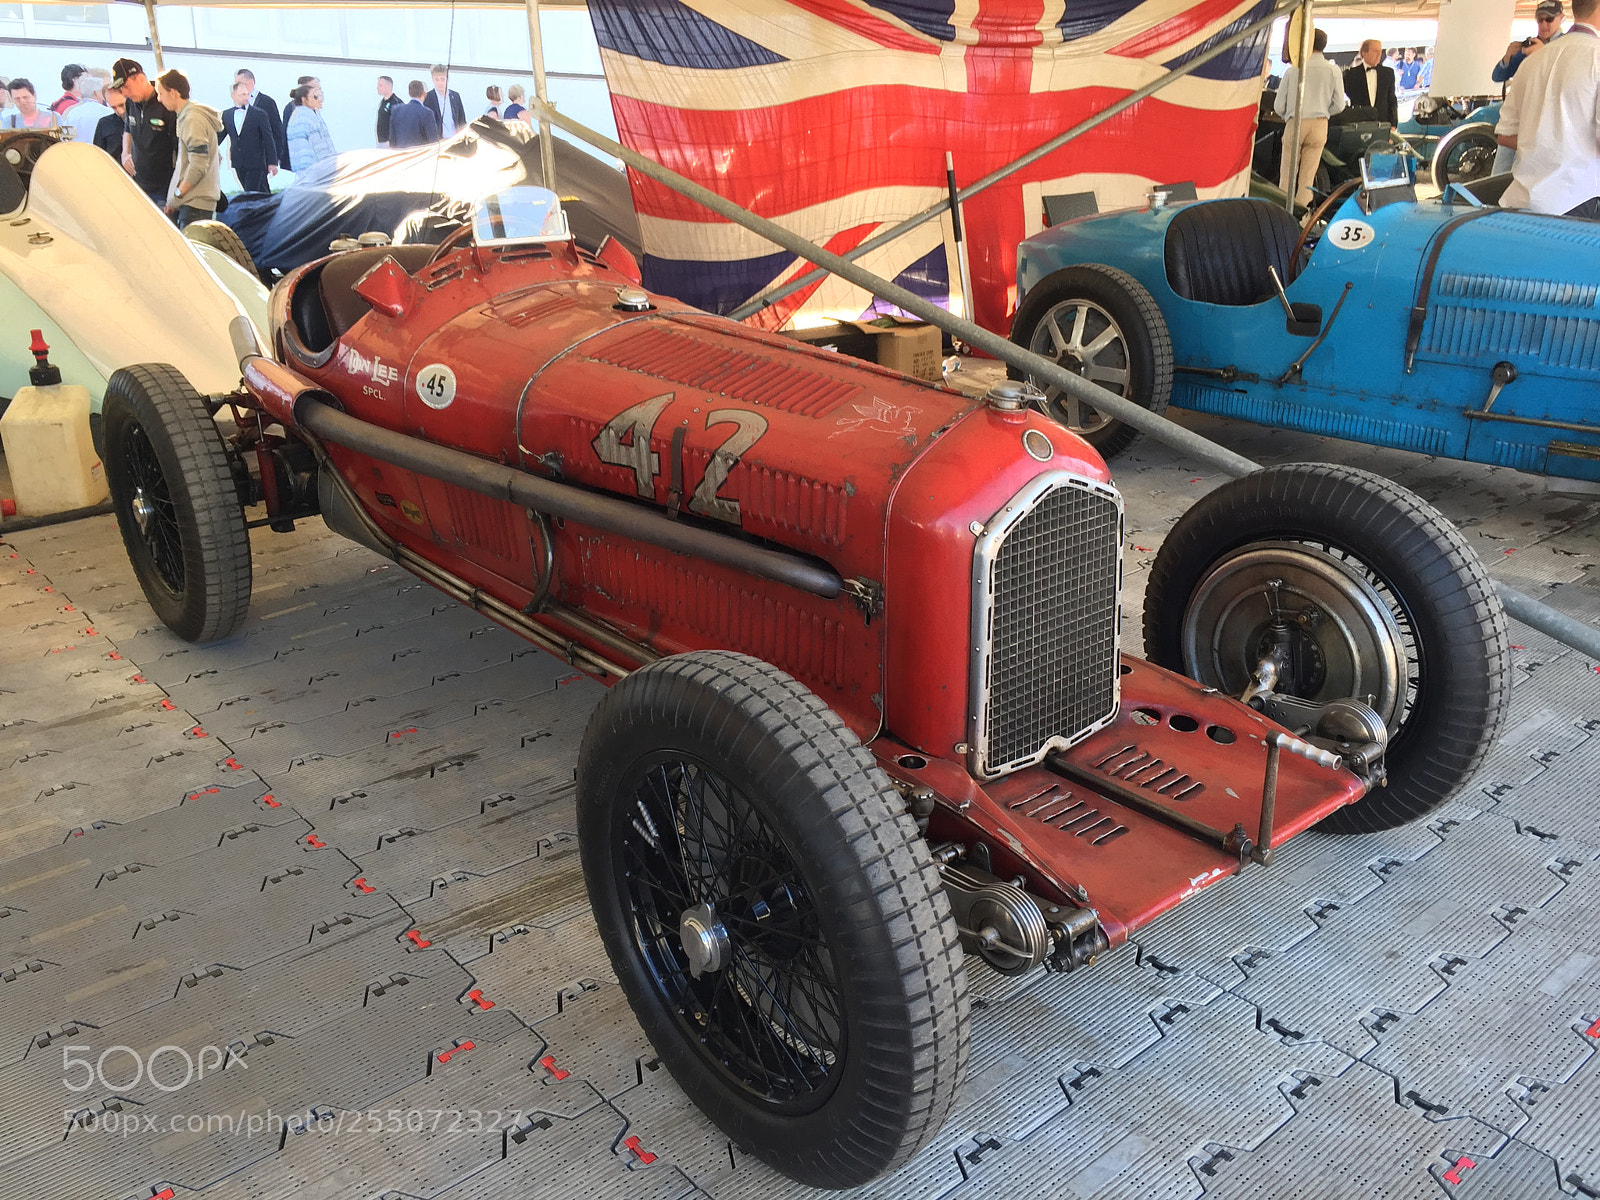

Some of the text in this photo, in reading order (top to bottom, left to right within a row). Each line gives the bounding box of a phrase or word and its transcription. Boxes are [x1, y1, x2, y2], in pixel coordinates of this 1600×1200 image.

[1340, 226, 1363, 241] 35
[371, 356, 398, 387] LEE
[426, 374, 446, 397] 45
[591, 392, 768, 525] 42
